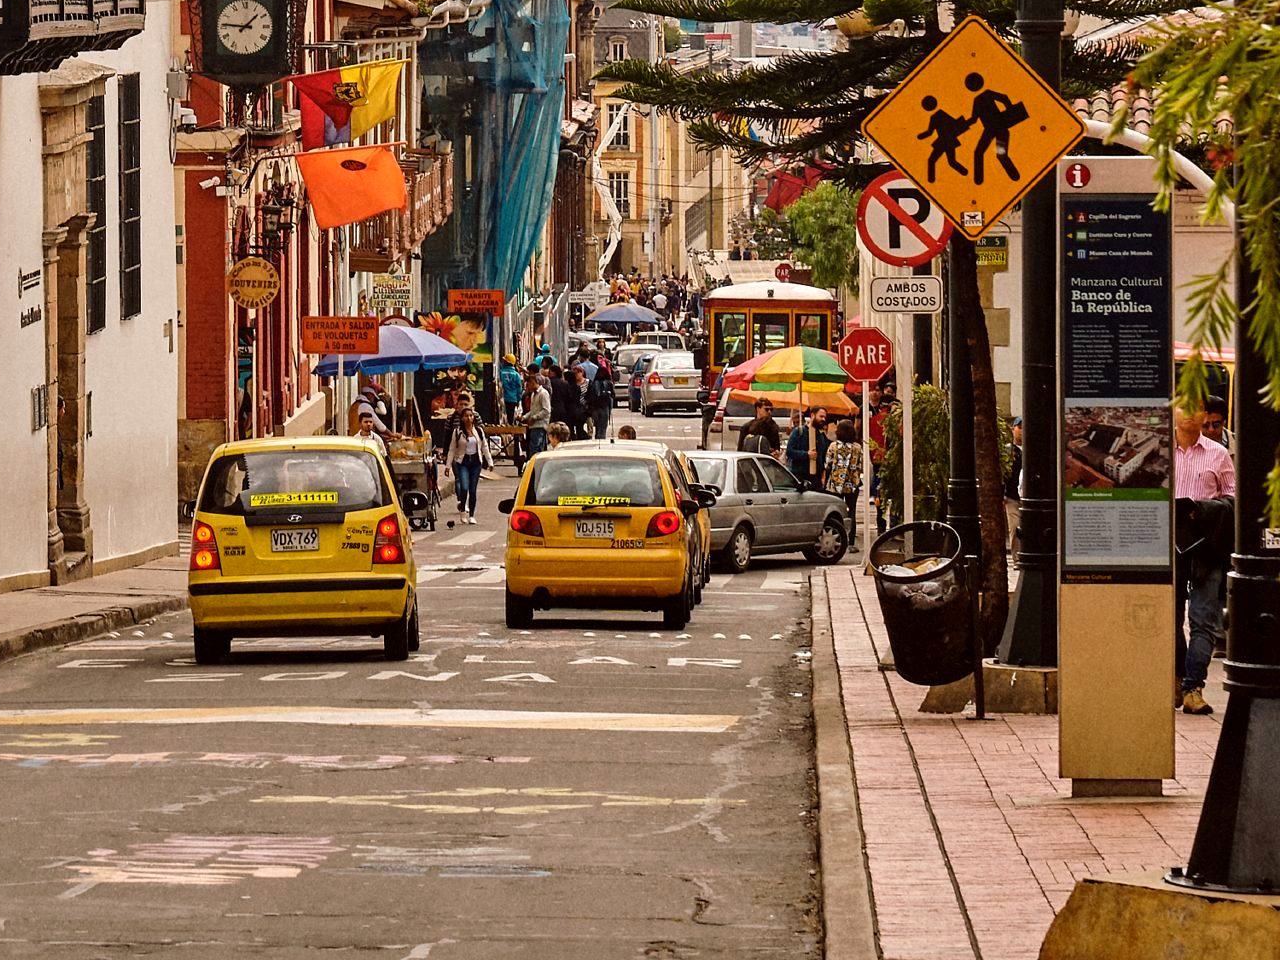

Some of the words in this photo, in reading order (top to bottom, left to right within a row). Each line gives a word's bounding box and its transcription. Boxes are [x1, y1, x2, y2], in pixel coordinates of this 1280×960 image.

[887, 188, 930, 248] P
[229, 279, 278, 289] SOUVENIRS
[1071, 277, 1118, 287] Manzana
[1120, 277, 1163, 287] Cultural
[885, 283, 926, 293] AMBOS
[1071, 290, 1112, 300] Banco
[1115, 289, 1131, 300] de
[876, 296, 936, 307] COSTADOS
[1071, 302, 1084, 313] la
[1087, 301, 1153, 316] República
[305, 321, 339, 330] ENTRADA
[342, 321, 347, 330] Y
[348, 321, 375, 330] SALIDA
[312, 331, 323, 340] DE
[324, 331, 368, 340] VOLQUETAS
[324, 341, 330, 350] A
[332, 341, 340, 350] 50
[342, 342, 356, 350] mts
[844, 344, 887, 366] PARE
[611, 539, 635, 549] 21065
[144, 670, 557, 683] ZONA
